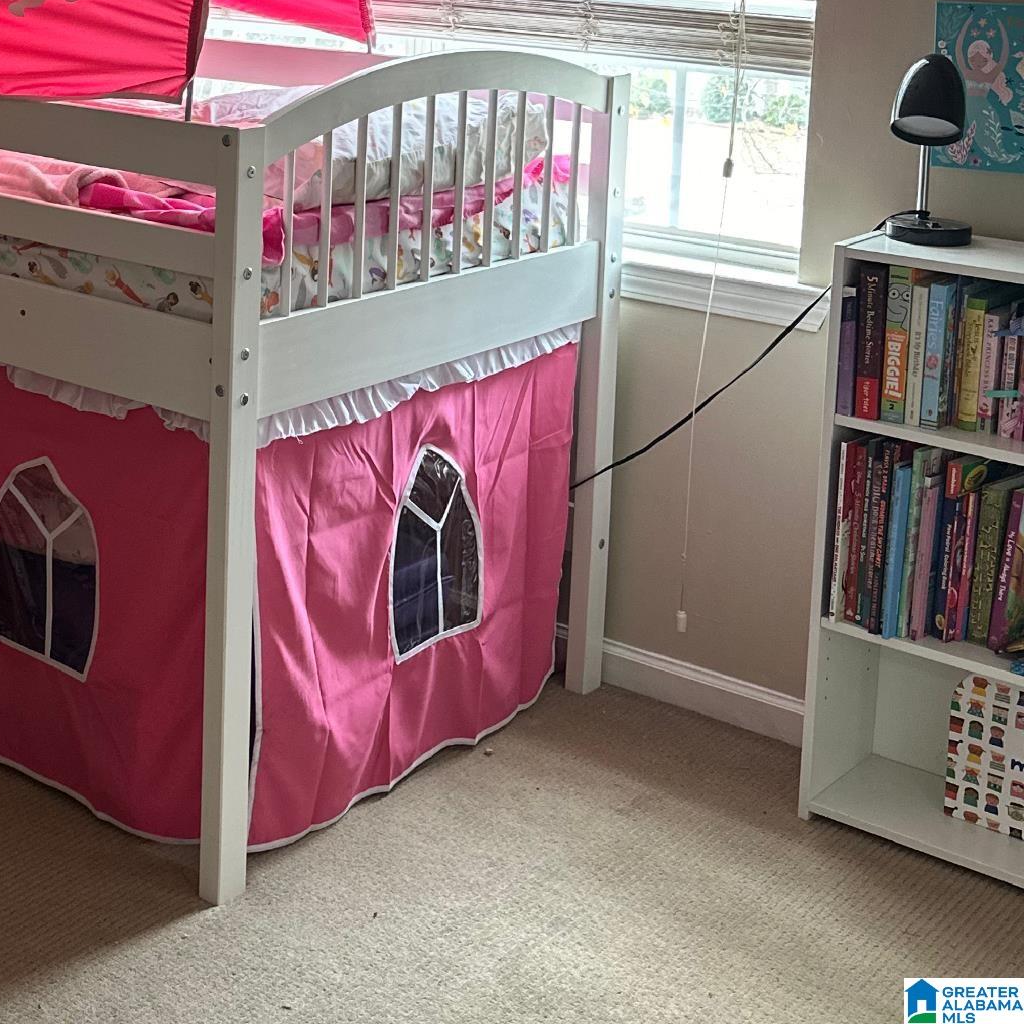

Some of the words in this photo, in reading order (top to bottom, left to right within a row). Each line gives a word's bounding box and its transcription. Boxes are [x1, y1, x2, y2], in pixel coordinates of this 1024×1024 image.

[866, 282, 876, 308] Minute
[864, 310, 874, 339] Bedtime
[927, 300, 943, 349] Fairies
[863, 341, 873, 364] Stories
[1004, 538, 1015, 556] Love
[941, 553, 949, 575] Coloring
[997, 584, 1006, 601] There
